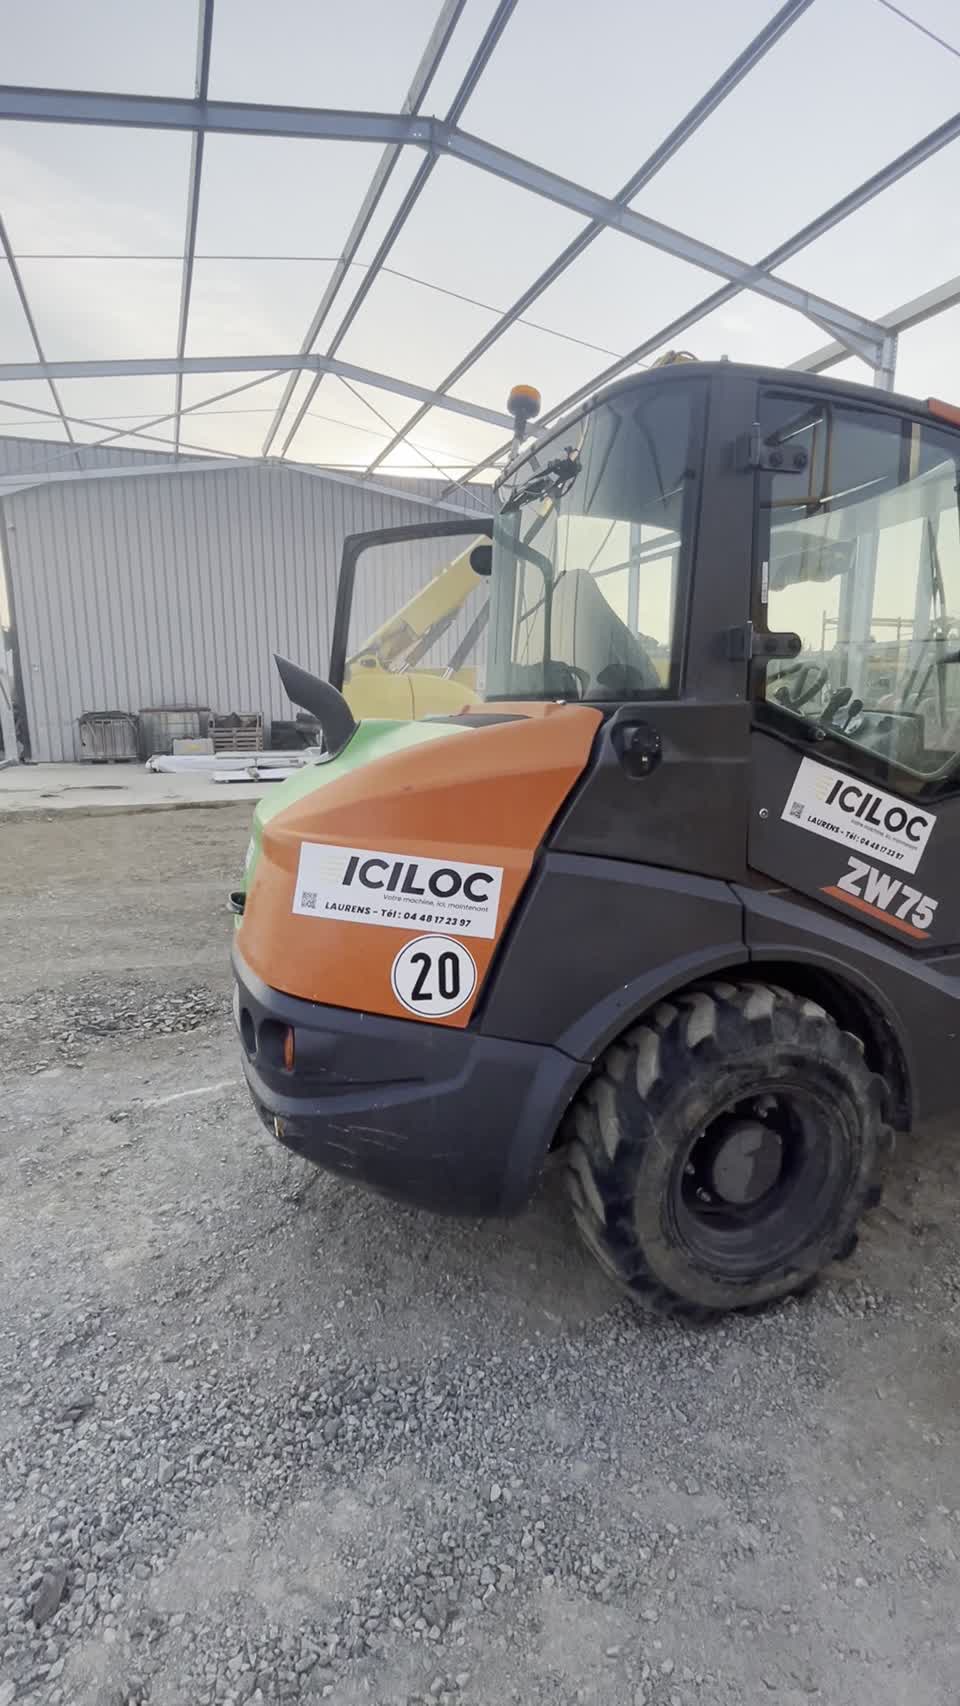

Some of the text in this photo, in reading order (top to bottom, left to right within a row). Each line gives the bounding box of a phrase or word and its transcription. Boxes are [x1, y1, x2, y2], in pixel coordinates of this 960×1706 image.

[807, 815, 840, 833] LAURENS
[825, 780, 928, 842] ICILOC
[342, 856, 494, 903] ICILOC
[837, 855, 938, 929] ZW75
[325, 901, 371, 915] LAURENS
[403, 912, 417, 921] 04
[419, 914, 433, 923] 48
[434, 916, 445, 924] 17
[445, 917, 458, 926] 23
[459, 919, 471, 928] 97
[383, 894, 402, 902] Votre
[447, 903, 489, 913] maintenant
[410, 951, 460, 1001] 20
